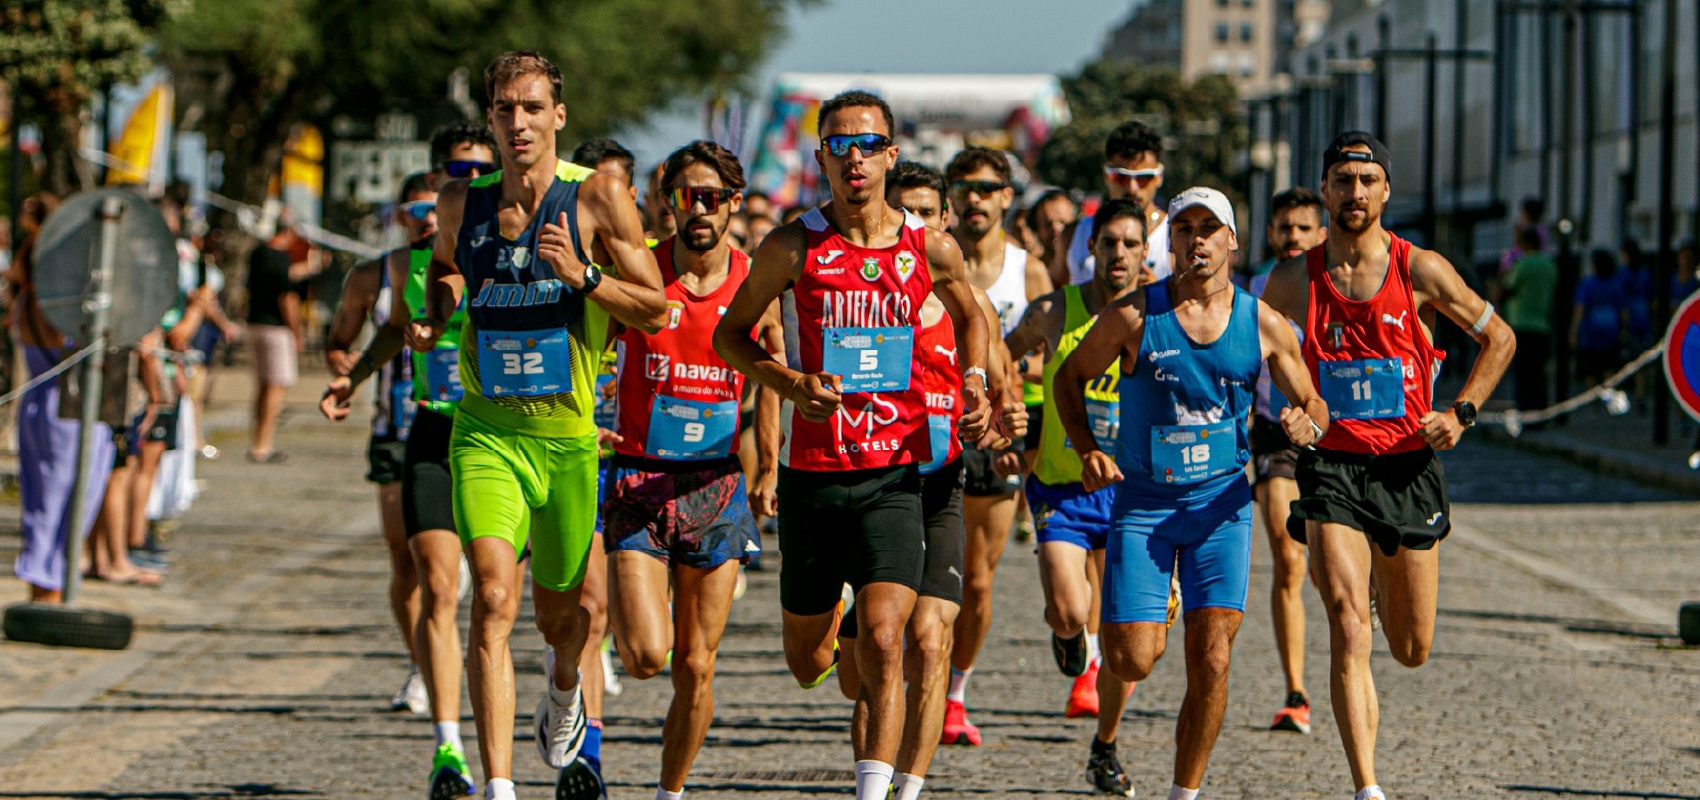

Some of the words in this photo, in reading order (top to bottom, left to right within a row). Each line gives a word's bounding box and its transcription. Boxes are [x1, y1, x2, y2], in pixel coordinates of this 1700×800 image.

[502, 352, 544, 375] 32
[859, 349, 878, 371] 5
[925, 391, 955, 410] arra
[1351, 380, 1372, 401] 11
[683, 422, 705, 443] 9
[1092, 418, 1120, 440] 31
[838, 439, 900, 454] HOTELS
[1181, 443, 1211, 465] 18
